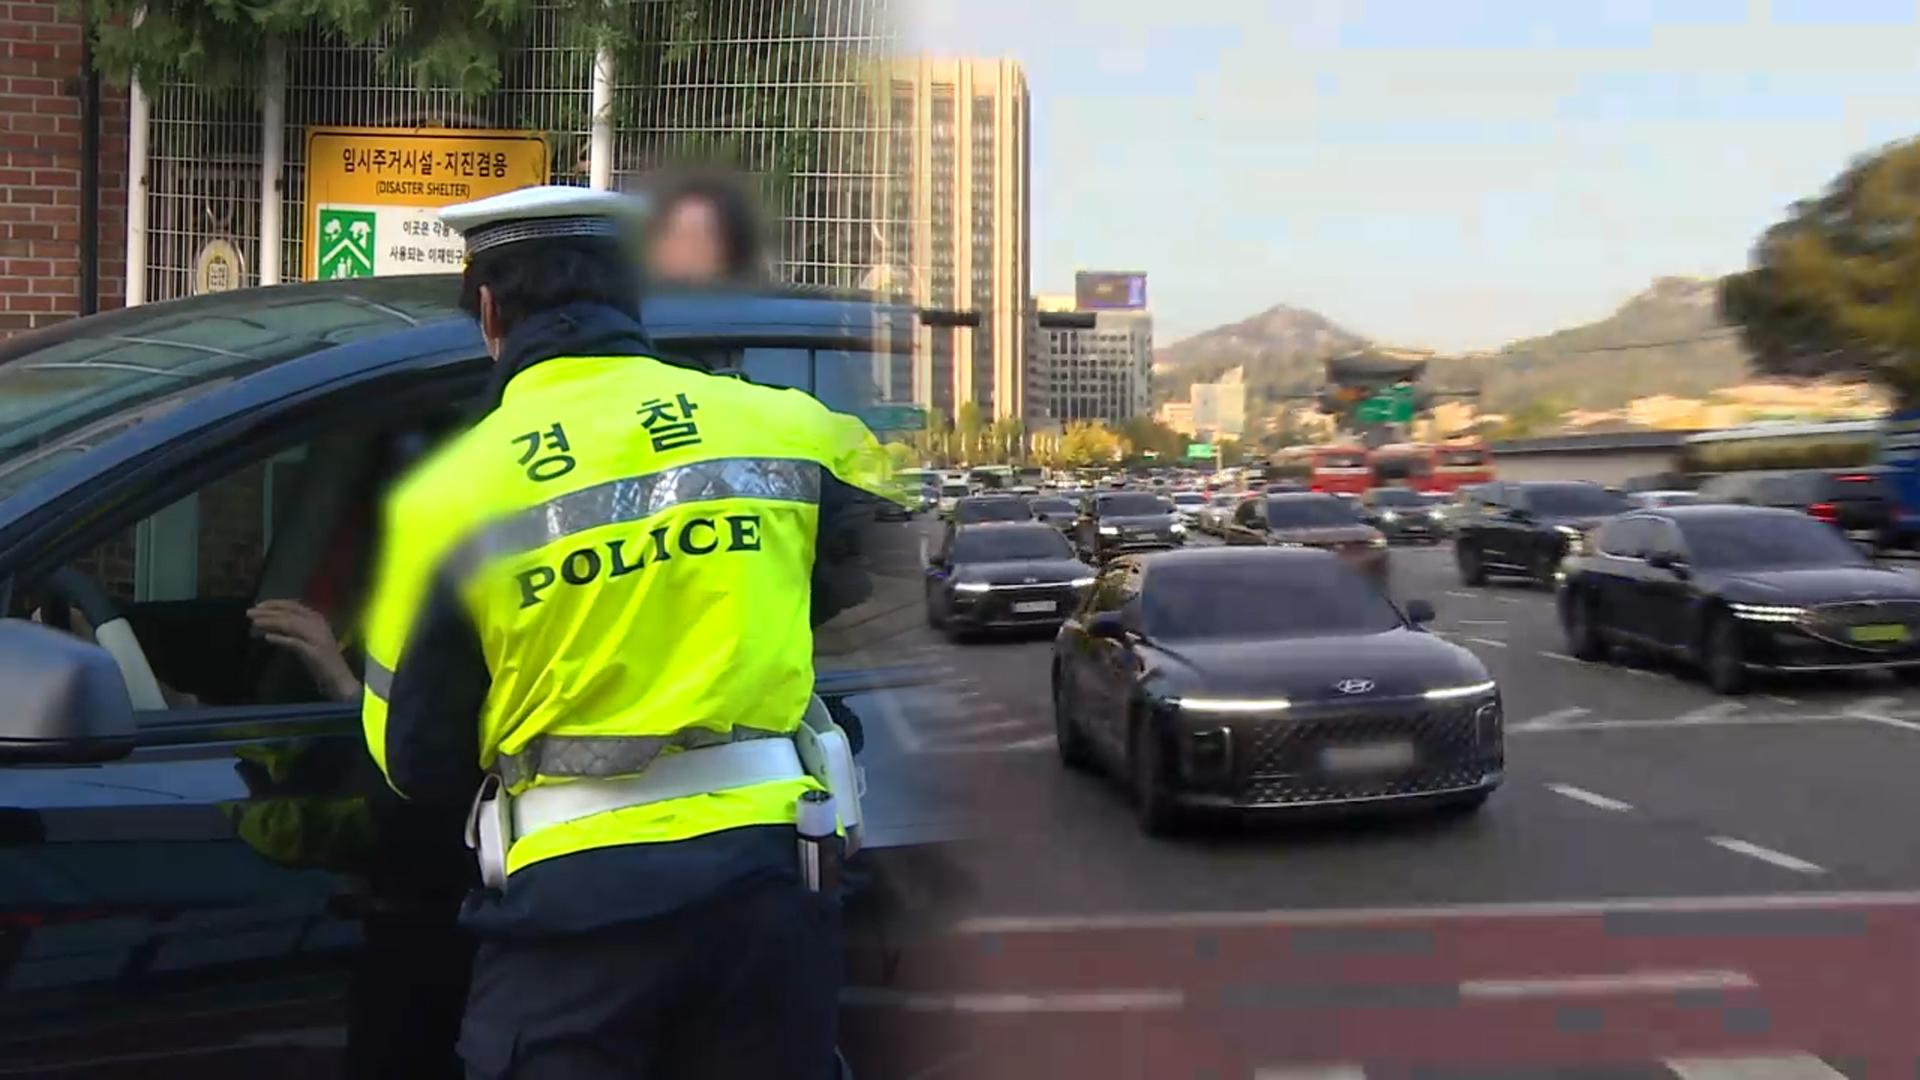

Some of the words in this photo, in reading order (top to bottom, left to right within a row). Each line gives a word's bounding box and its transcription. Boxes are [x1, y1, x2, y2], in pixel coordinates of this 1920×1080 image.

[376, 180, 424, 197] (DISASTER
[426, 182, 470, 199] SHELTER)
[403, 220, 429, 236] 이곳은
[427, 248, 463, 264] 이재민구
[515, 516, 762, 610] POLICE
